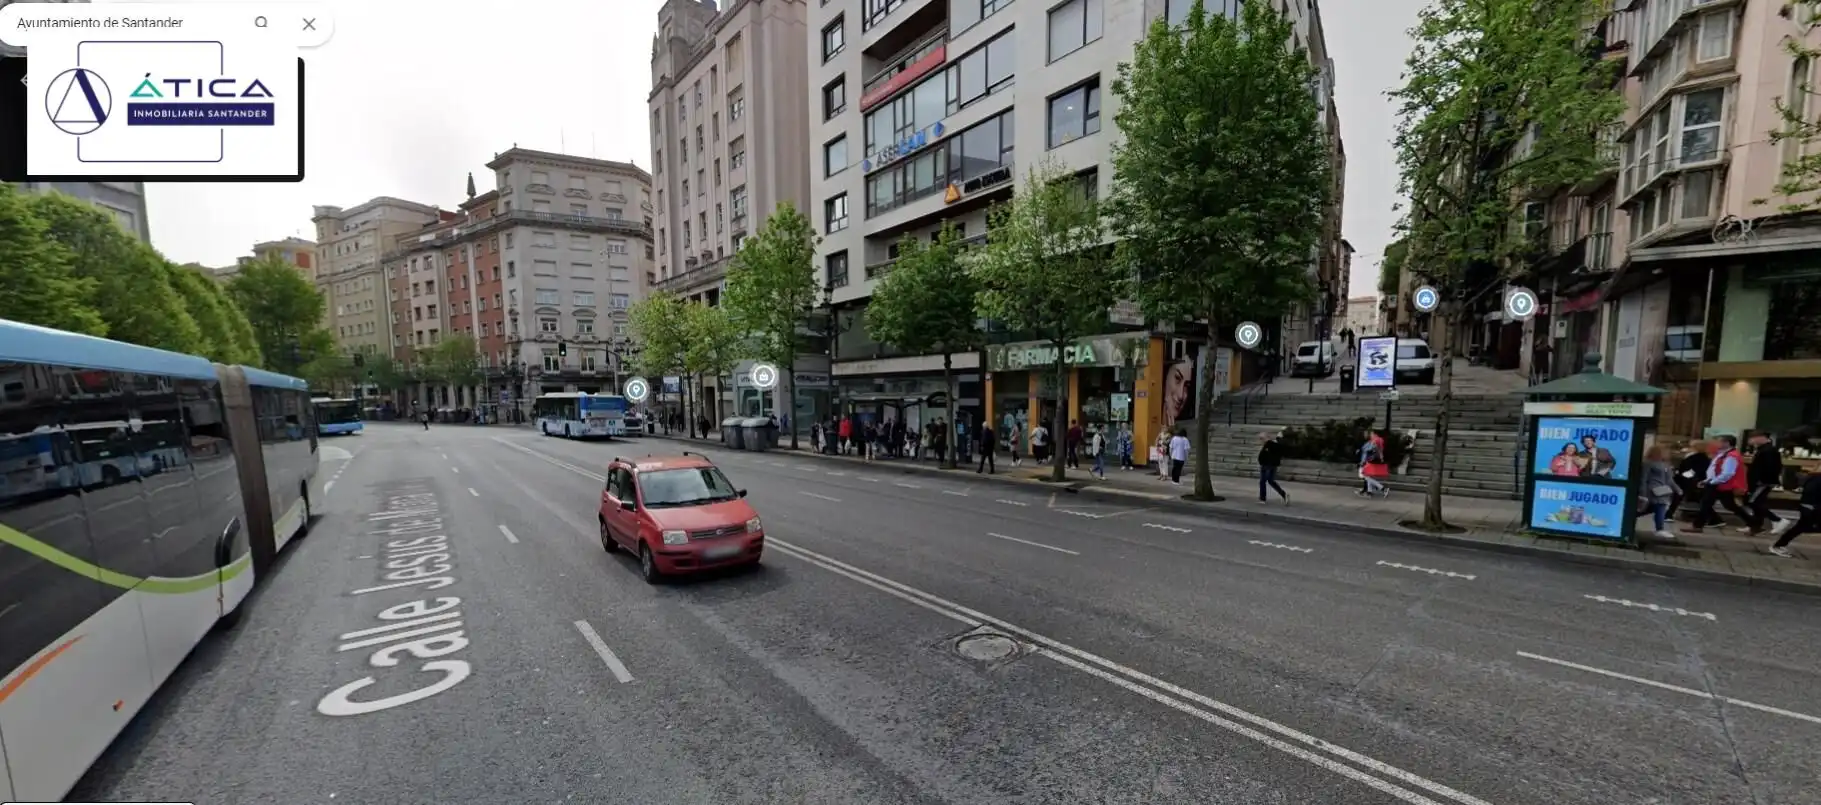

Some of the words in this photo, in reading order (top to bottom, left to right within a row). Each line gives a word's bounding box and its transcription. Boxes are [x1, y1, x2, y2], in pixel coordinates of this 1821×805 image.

[1008, 345, 1096, 366] FARMACIA
[1540, 427, 1570, 440] BIEN
[1573, 427, 1630, 442] JUGADO
[1540, 487, 1567, 501] BIEN
[1568, 490, 1618, 506] JUGADO
